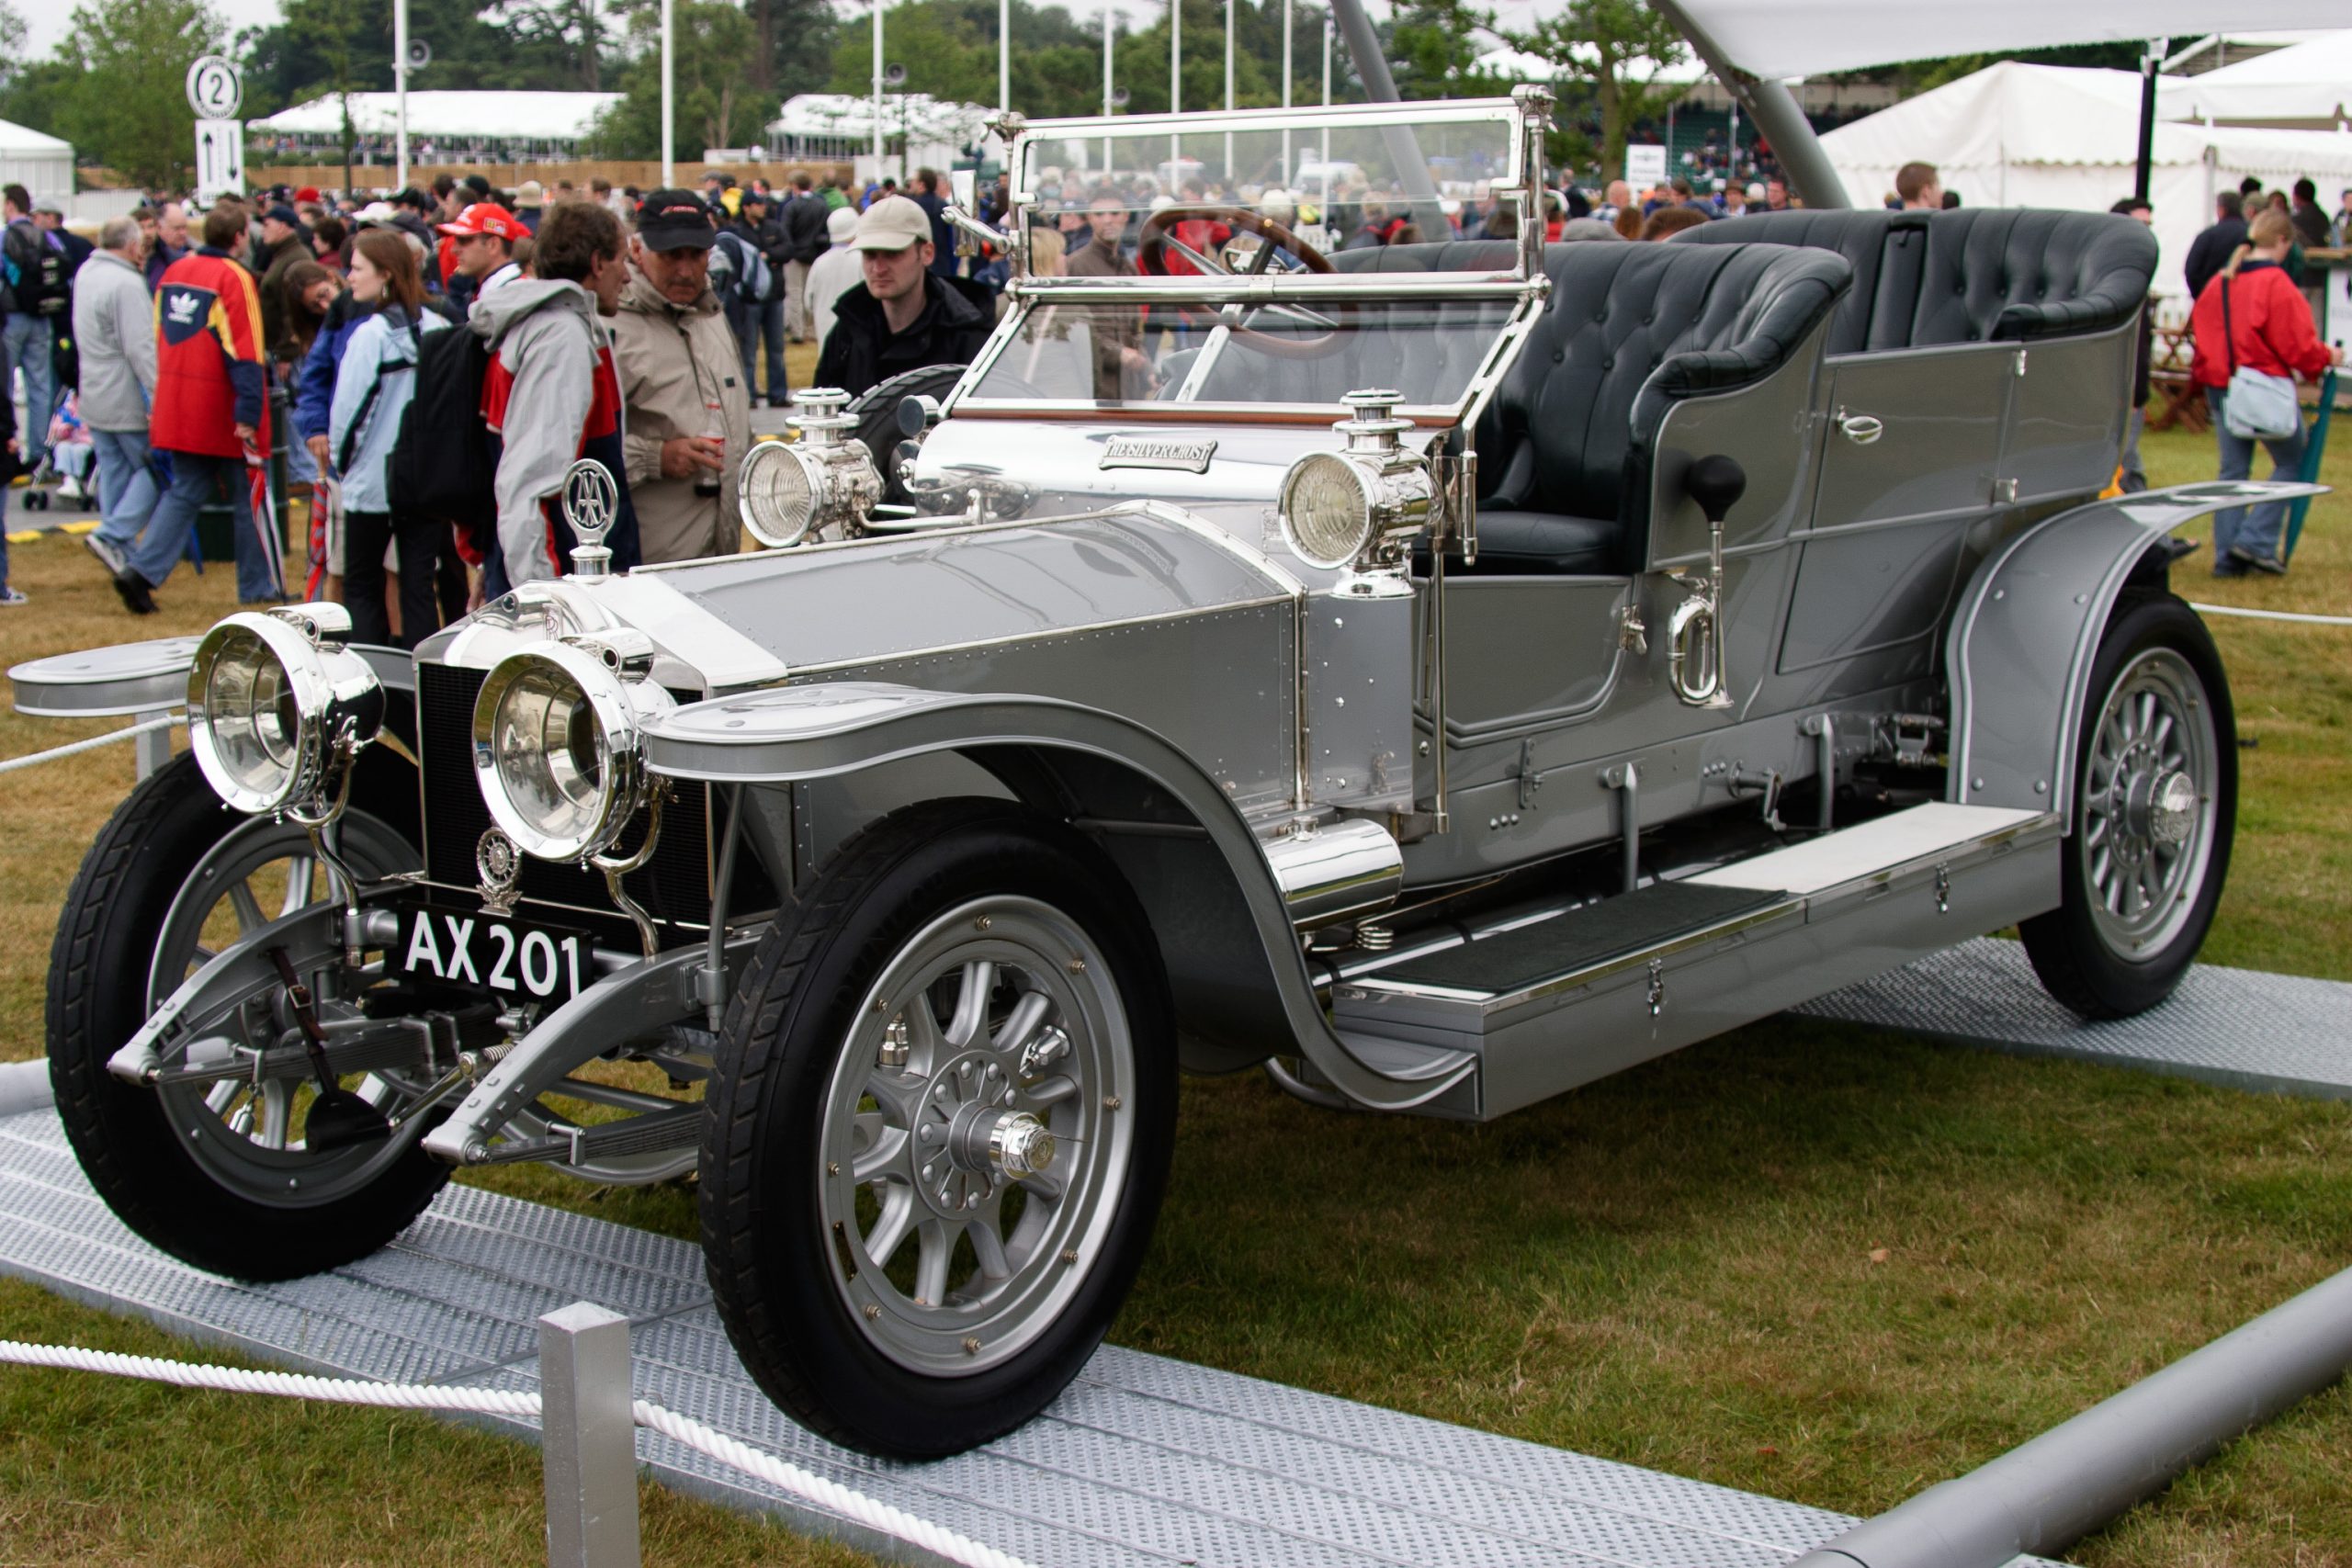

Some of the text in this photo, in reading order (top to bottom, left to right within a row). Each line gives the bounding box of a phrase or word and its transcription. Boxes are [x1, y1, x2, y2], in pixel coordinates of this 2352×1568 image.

[209, 73, 223, 104] 2
[1106, 441, 1211, 460] THE SILVER GHOST
[404, 910, 580, 1000] AX 201
